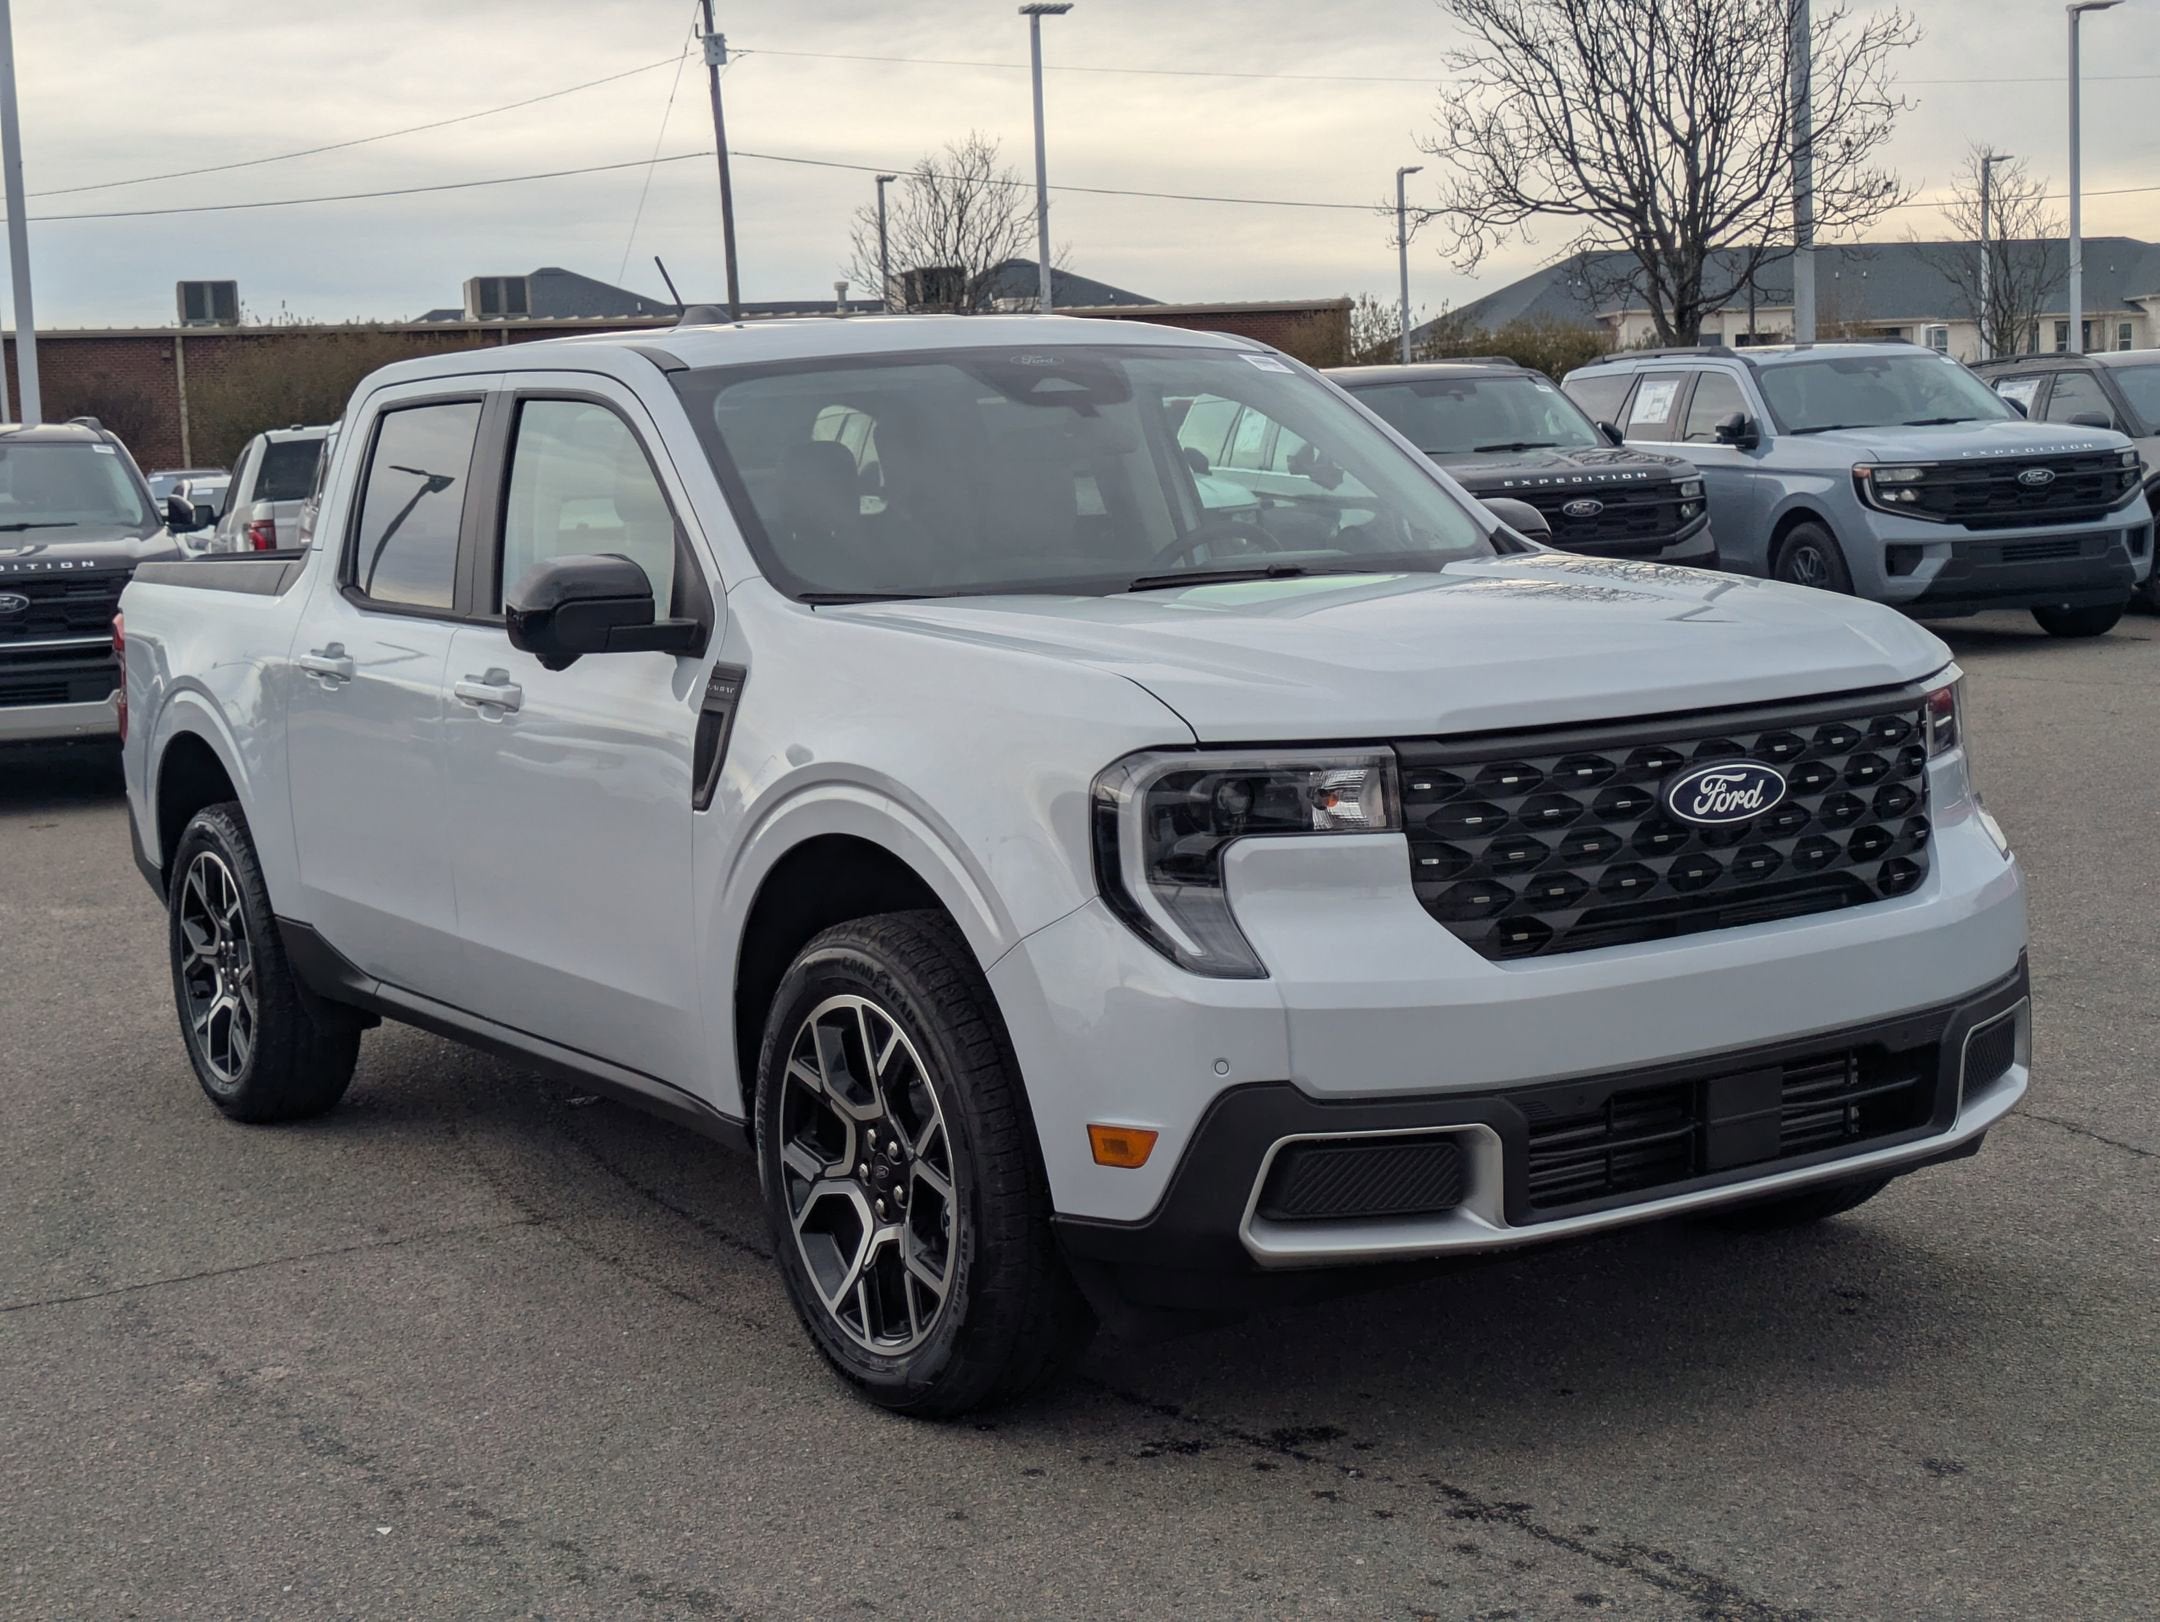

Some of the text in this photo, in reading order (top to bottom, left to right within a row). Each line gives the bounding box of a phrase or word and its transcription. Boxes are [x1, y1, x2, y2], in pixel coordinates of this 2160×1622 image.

[1021, 354, 1054, 366] Ford
[1962, 442, 2093, 457] EXPEDITION
[1503, 472, 1648, 487] EXPEDITION
[2025, 471, 2049, 483] Ford
[1570, 502, 1597, 514] Ford
[1693, 772, 1765, 815] Ford
